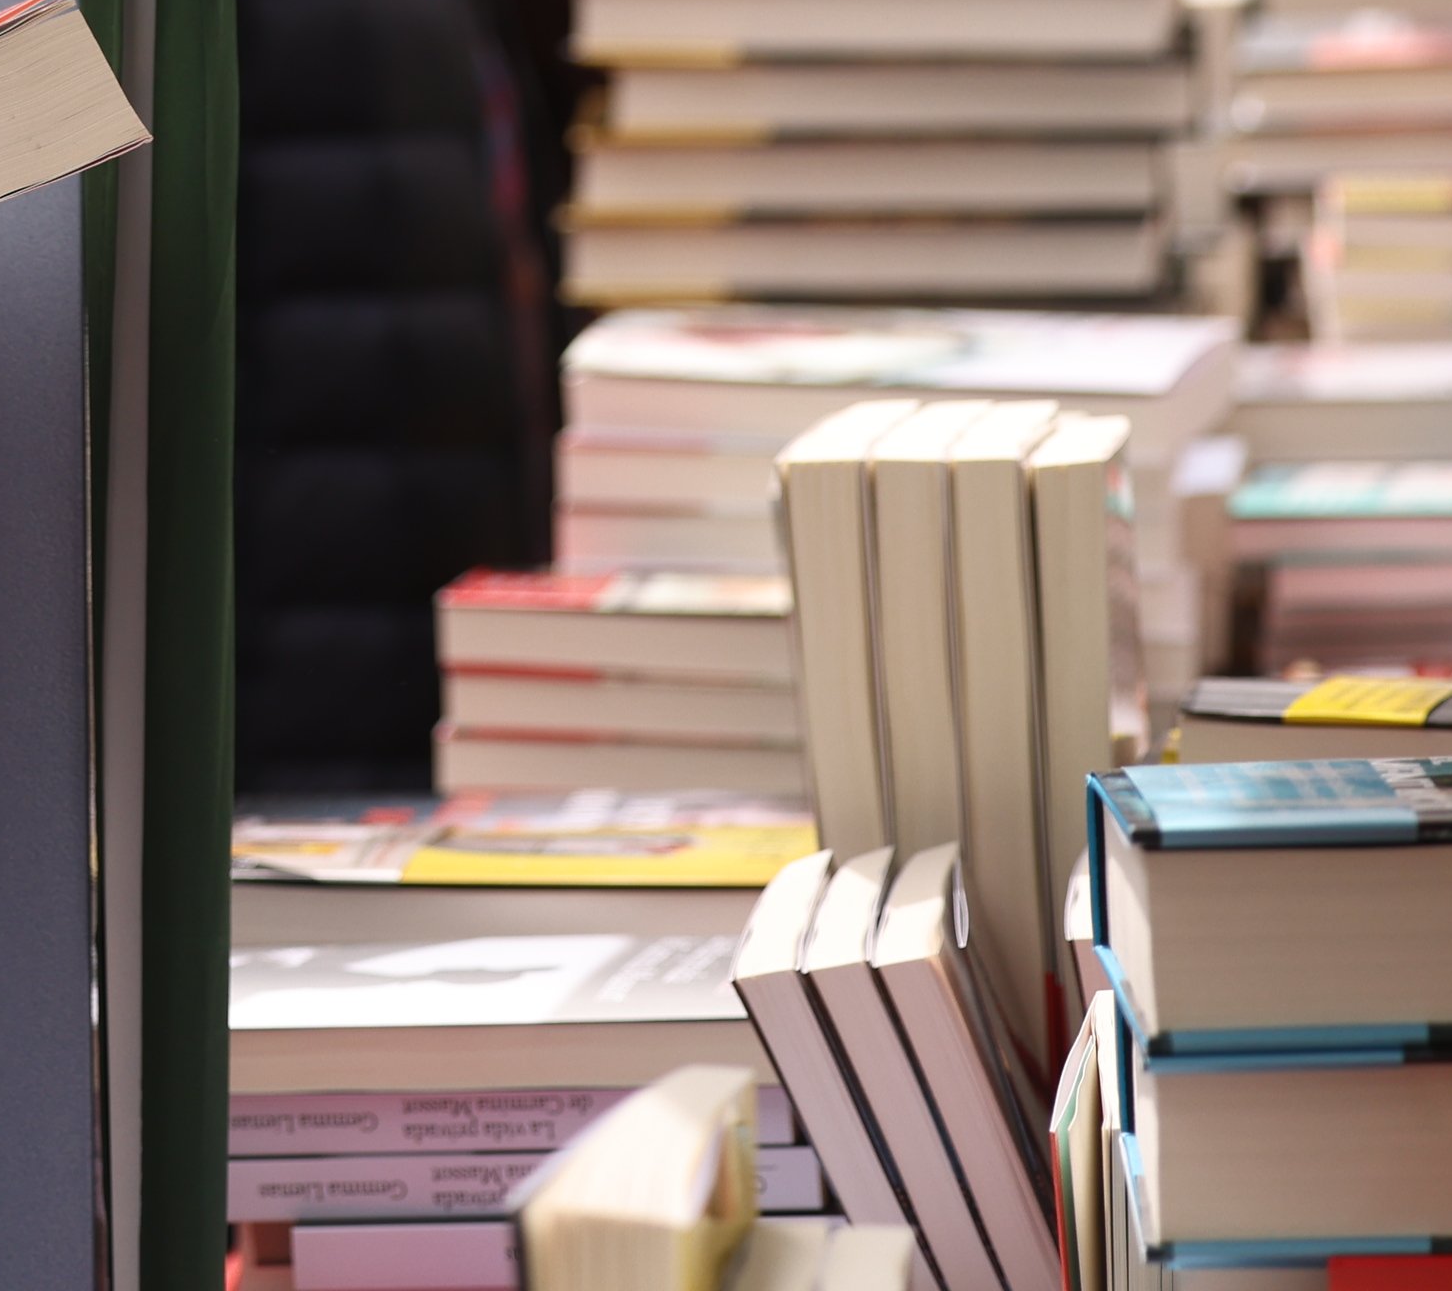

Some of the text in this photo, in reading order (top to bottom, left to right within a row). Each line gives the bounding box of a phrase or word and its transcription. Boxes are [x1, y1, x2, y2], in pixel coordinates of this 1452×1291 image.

[403, 1094, 594, 1115] de Carmina Massot
[230, 1111, 379, 1133] Gemma Lienas
[403, 1119, 556, 1140] La vida privada
[431, 1165, 500, 1186] Massot
[260, 1180, 408, 1202] Gemma Lienas
